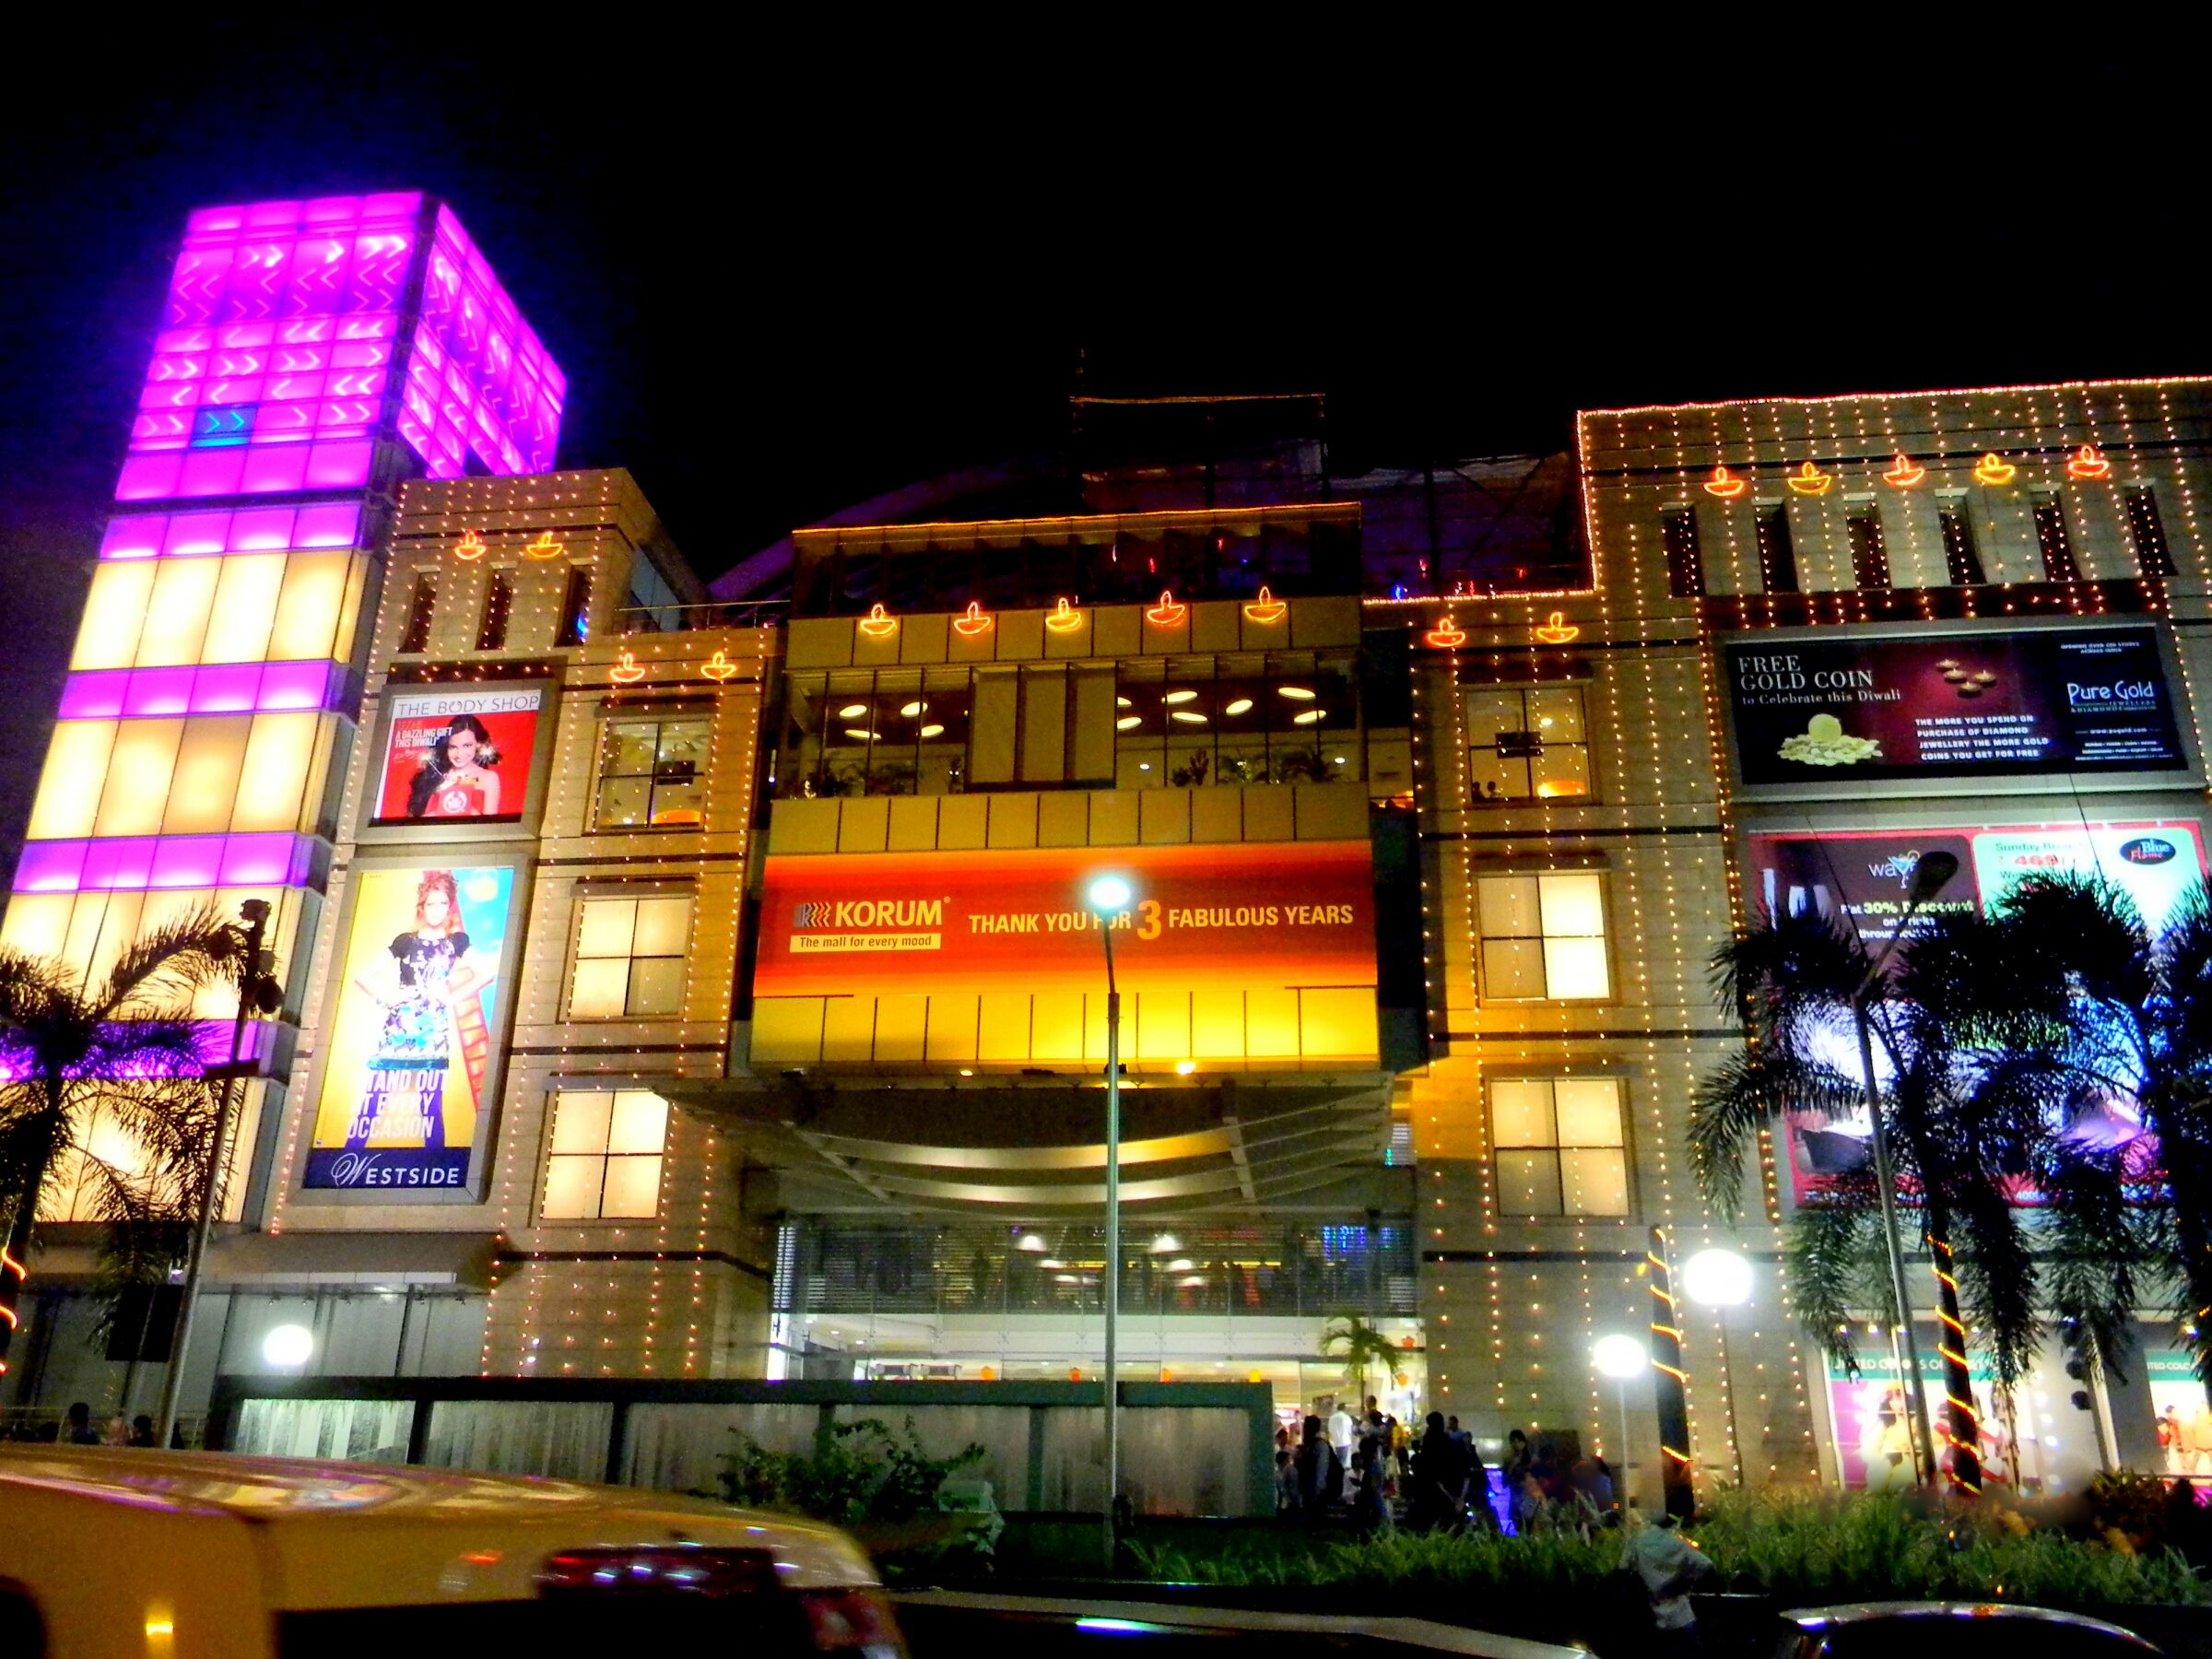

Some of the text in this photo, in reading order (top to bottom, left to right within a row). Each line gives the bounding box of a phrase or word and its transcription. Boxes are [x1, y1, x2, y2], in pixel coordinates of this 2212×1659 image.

[1739, 655, 1801, 673] FREE
[1740, 670, 1874, 691] GOLD COIN
[1742, 689, 1901, 705] to Celebrate this Diwali
[2066, 680, 2154, 705] Pure Gold
[399, 696, 539, 716] THE BODY SHOP
[1986, 715, 2017, 724] SPEND
[2019, 714, 2034, 723] ON
[402, 728, 436, 739] DAZZLING
[437, 726, 453, 737] GIFT
[1917, 726, 2029, 737] PURCHASE OF DIAMOND
[395, 738, 411, 748] THIS
[1919, 737, 2049, 749] JEWELLERY THE MORE GOLD
[1921, 748, 2039, 760] COINS YOU GET FOR FREE
[2140, 839, 2170, 853] Blue
[2130, 846, 2163, 863] Flame
[835, 900, 942, 927] KORUM
[1864, 901, 1899, 914] 30%
[969, 913, 1040, 934] THANK
[1045, 911, 1087, 932] YOU
[1137, 900, 1161, 940] 3
[1169, 907, 1279, 928] FABULOUS
[1285, 904, 1354, 925] YEARS
[1882, 917, 1898, 927] on
[800, 935, 932, 949] The mall for every mood
[362, 1069, 448, 1091] TAND OUT
[347, 1116, 435, 1138] OCCASION
[331, 1152, 460, 1186] WESTSIDE
[1835, 1359, 1877, 1371] UED
[1878, 1358, 1927, 1371] COOS
